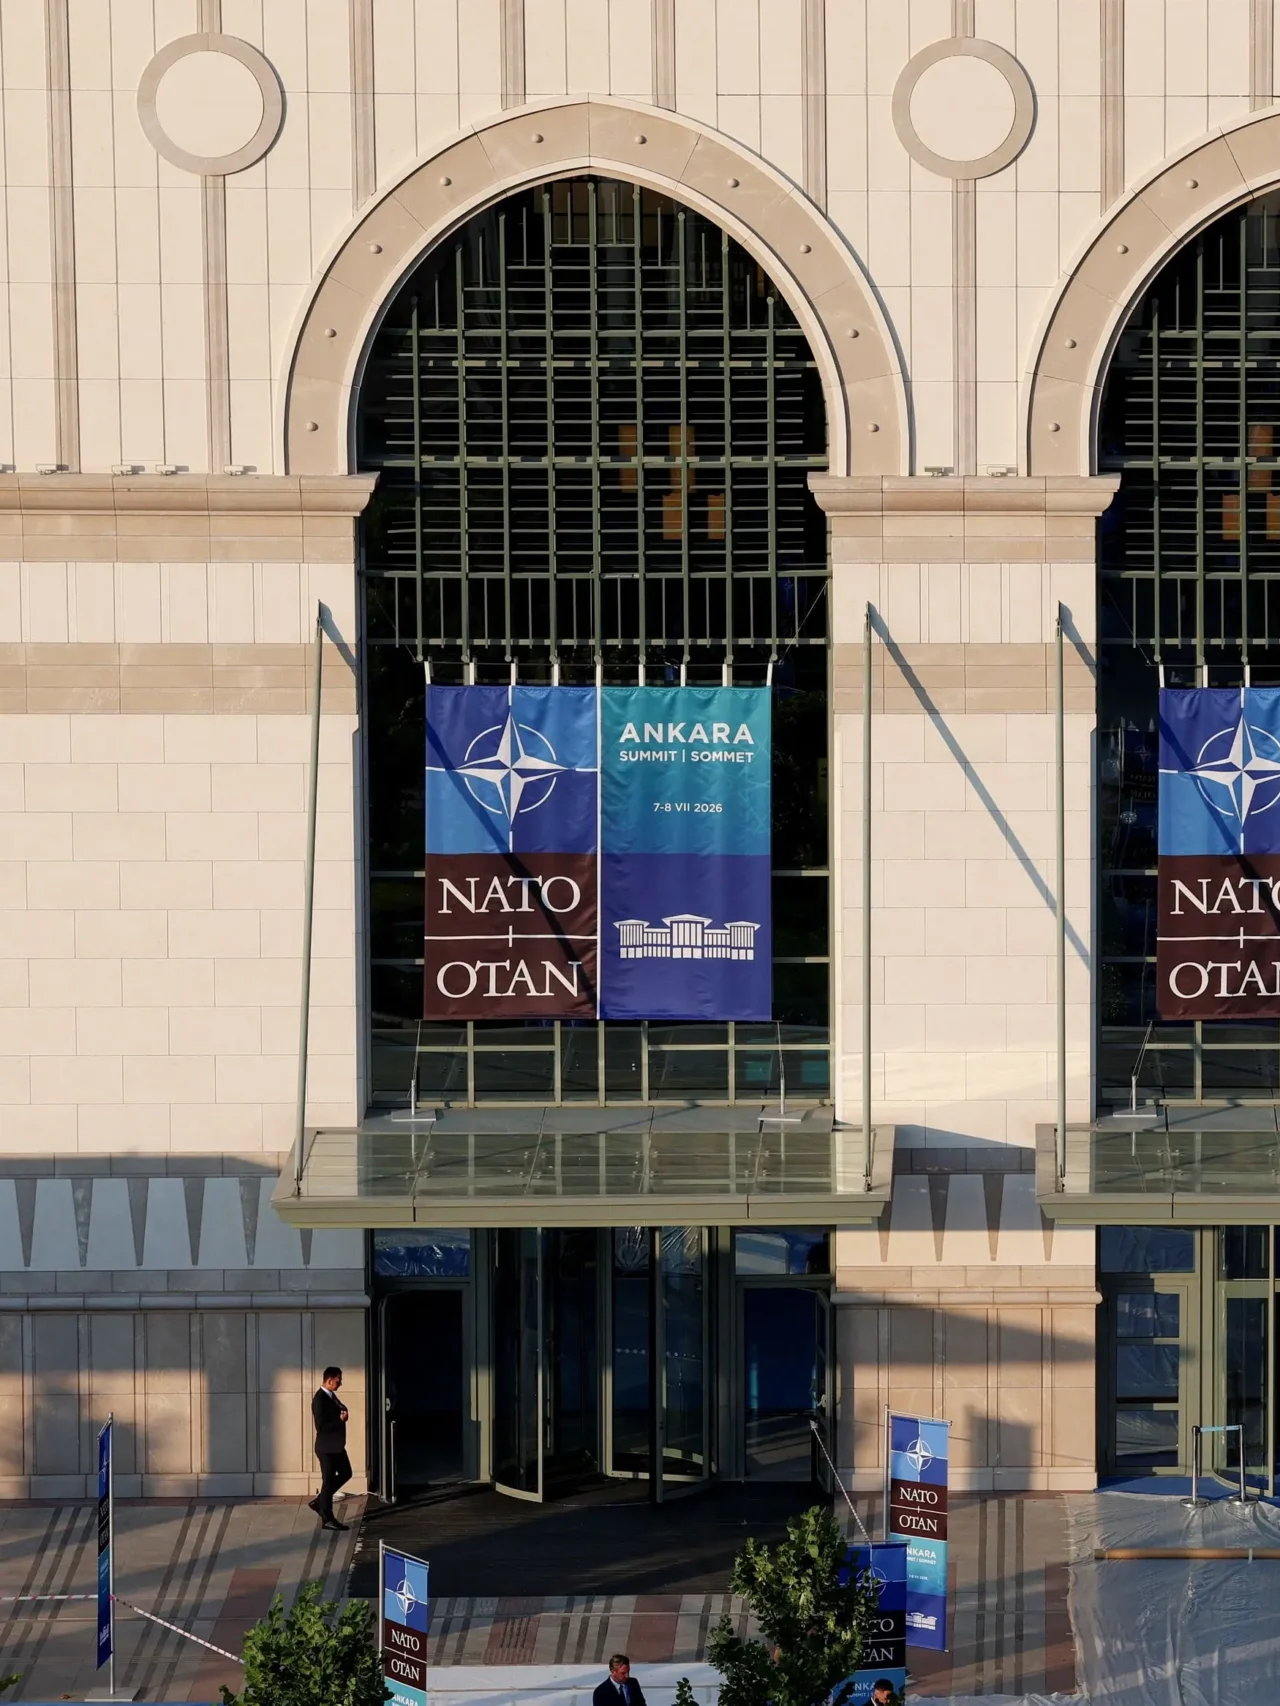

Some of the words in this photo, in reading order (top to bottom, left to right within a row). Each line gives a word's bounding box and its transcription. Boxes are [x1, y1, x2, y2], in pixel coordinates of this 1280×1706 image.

[619, 721, 755, 745] ANKARA
[619, 750, 678, 762] SUMMIT
[690, 750, 755, 763] SOMMET
[653, 802, 672, 812] 7-8
[675, 802, 690, 812] VII
[694, 803, 723, 813] 2026
[437, 874, 581, 914] NATO
[436, 959, 582, 999] OTAN
[899, 1486, 939, 1505] NATO
[899, 1514, 938, 1533] OTAN
[906, 1546, 937, 1559] NKARA
[391, 1628, 420, 1652] NATO
[863, 1647, 895, 1663] TAN
[391, 1658, 420, 1682] OTAN
